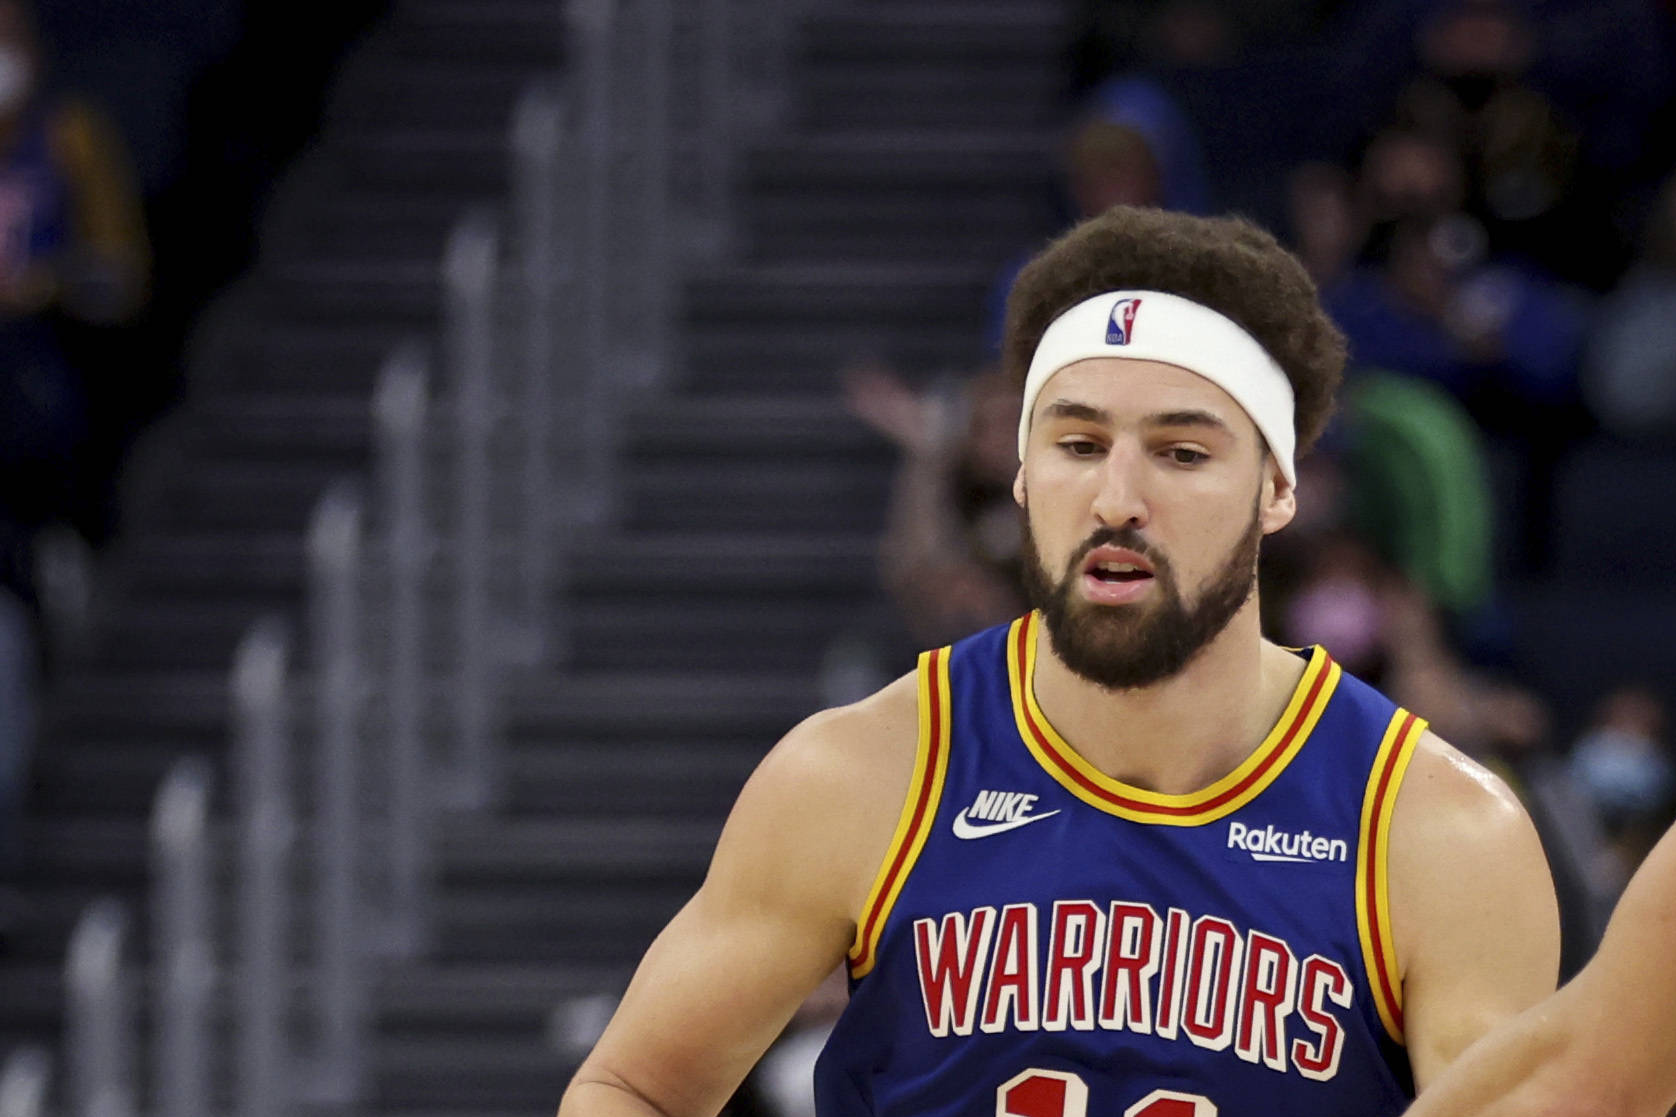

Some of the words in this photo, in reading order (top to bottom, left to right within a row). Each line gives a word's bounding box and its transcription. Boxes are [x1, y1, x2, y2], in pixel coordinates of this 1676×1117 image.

[967, 790, 1039, 822] NIKE
[1227, 822, 1347, 862] Rakuten
[914, 900, 1353, 1081] WARRIORS
